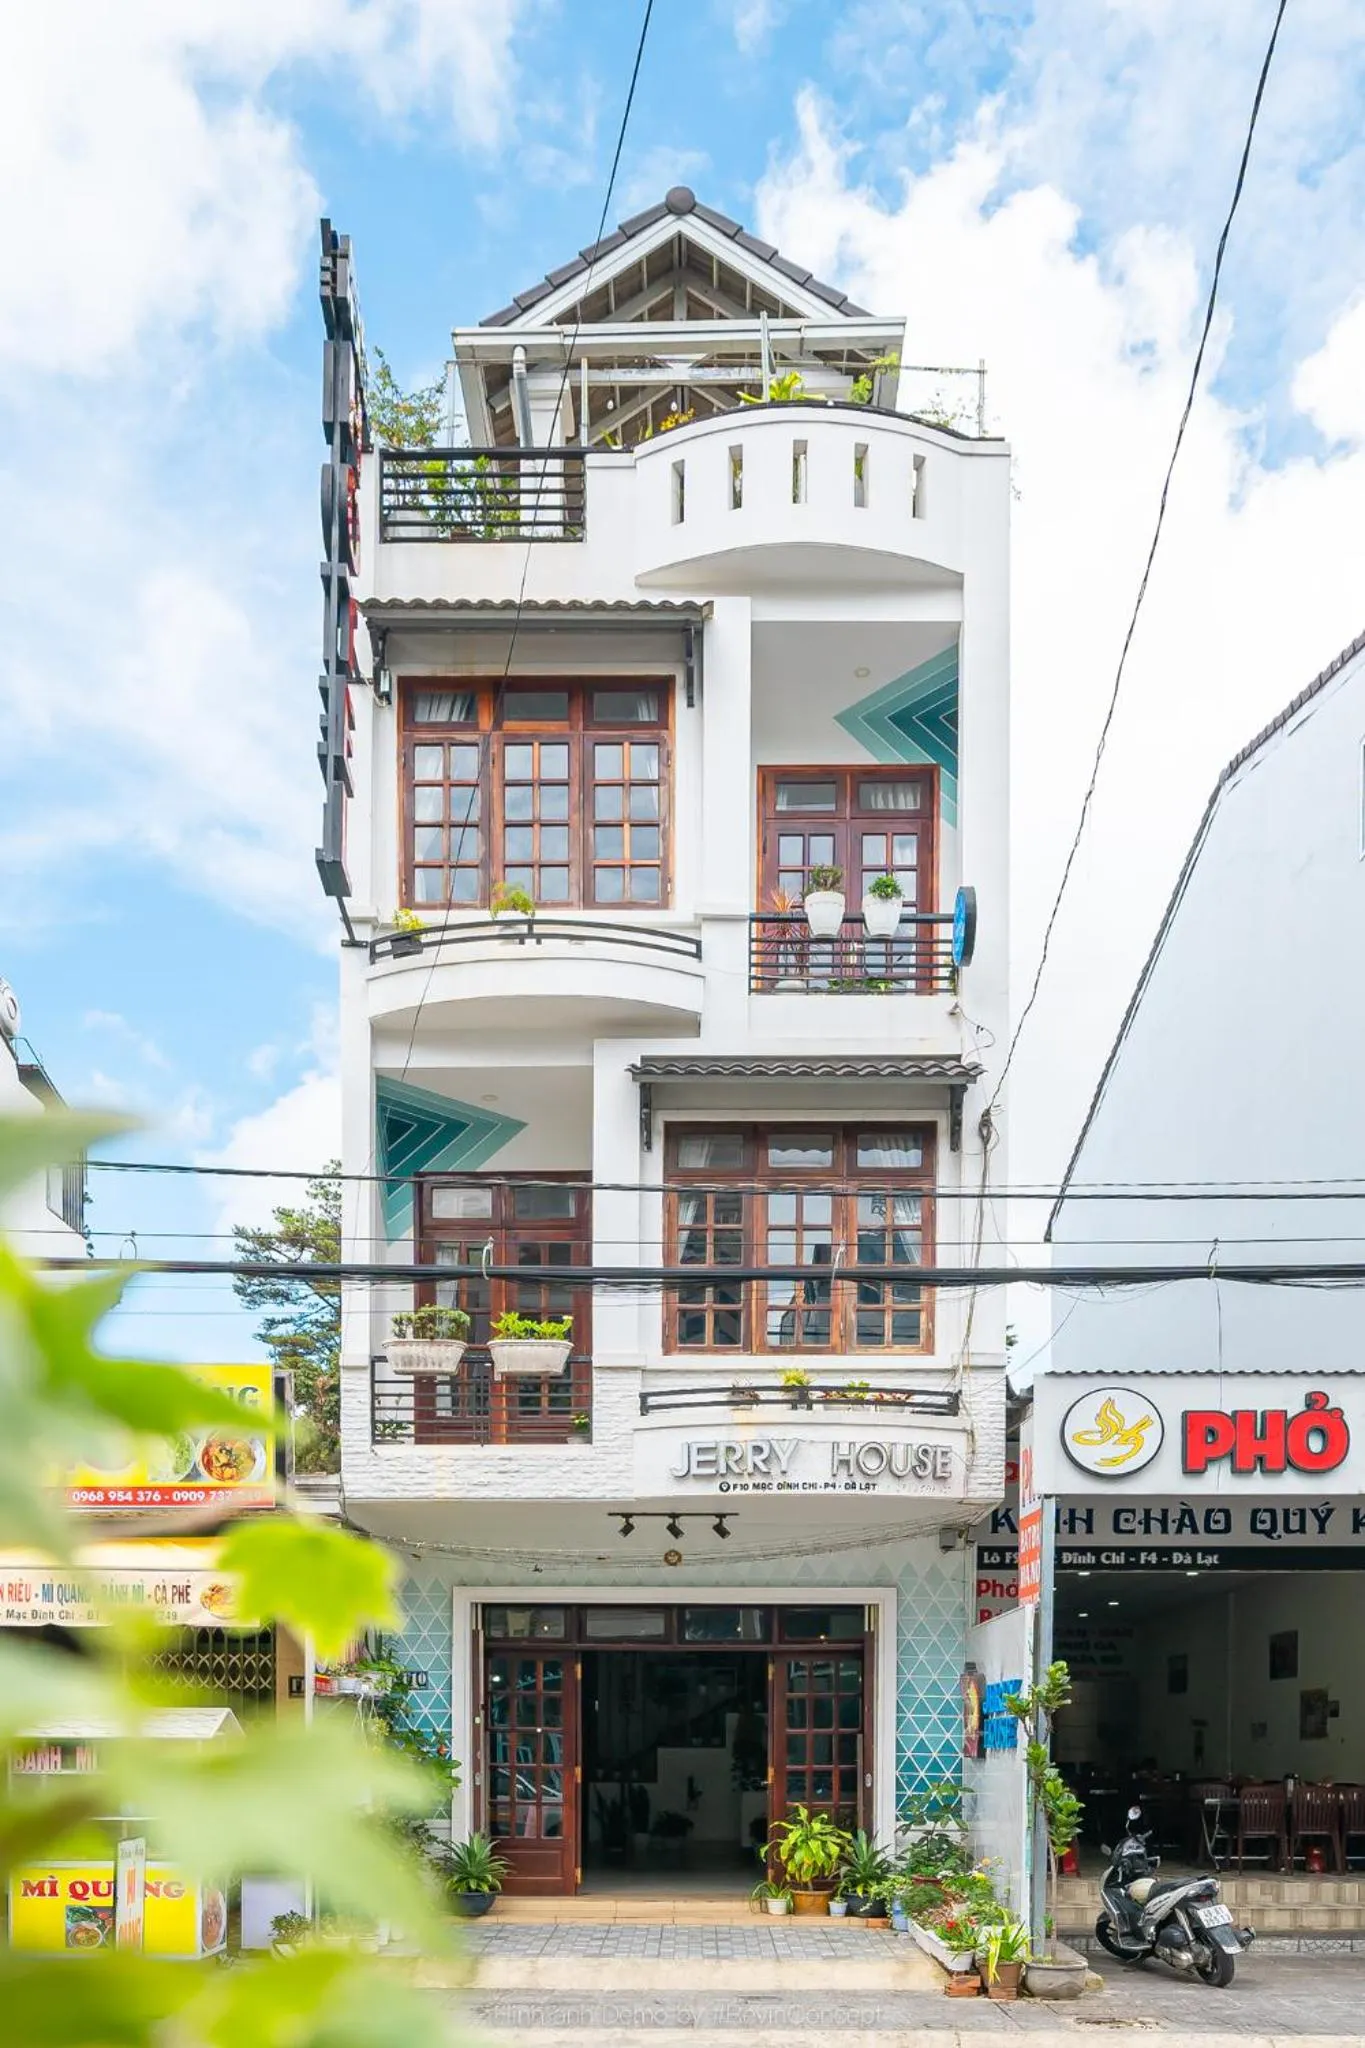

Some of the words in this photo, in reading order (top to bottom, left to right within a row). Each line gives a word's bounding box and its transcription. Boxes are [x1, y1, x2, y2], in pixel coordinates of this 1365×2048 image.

[1182, 1391, 1350, 1474] PHỞ
[669, 1438, 799, 1478] JERRY
[831, 1441, 953, 1480] HOUSE
[72, 1491, 104, 1502] 0968
[108, 1491, 132, 1502] 954
[136, 1491, 161, 1502] 376
[172, 1491, 205, 1502] 0909
[1112, 1501, 1232, 1535] CHÀO
[1250, 1501, 1336, 1540] QUÝ
[1101, 1551, 1125, 1564] Chi
[1140, 1551, 1158, 1564] F4
[21, 1875, 59, 1898] MÌ
[68, 1879, 185, 1901] QUNG
